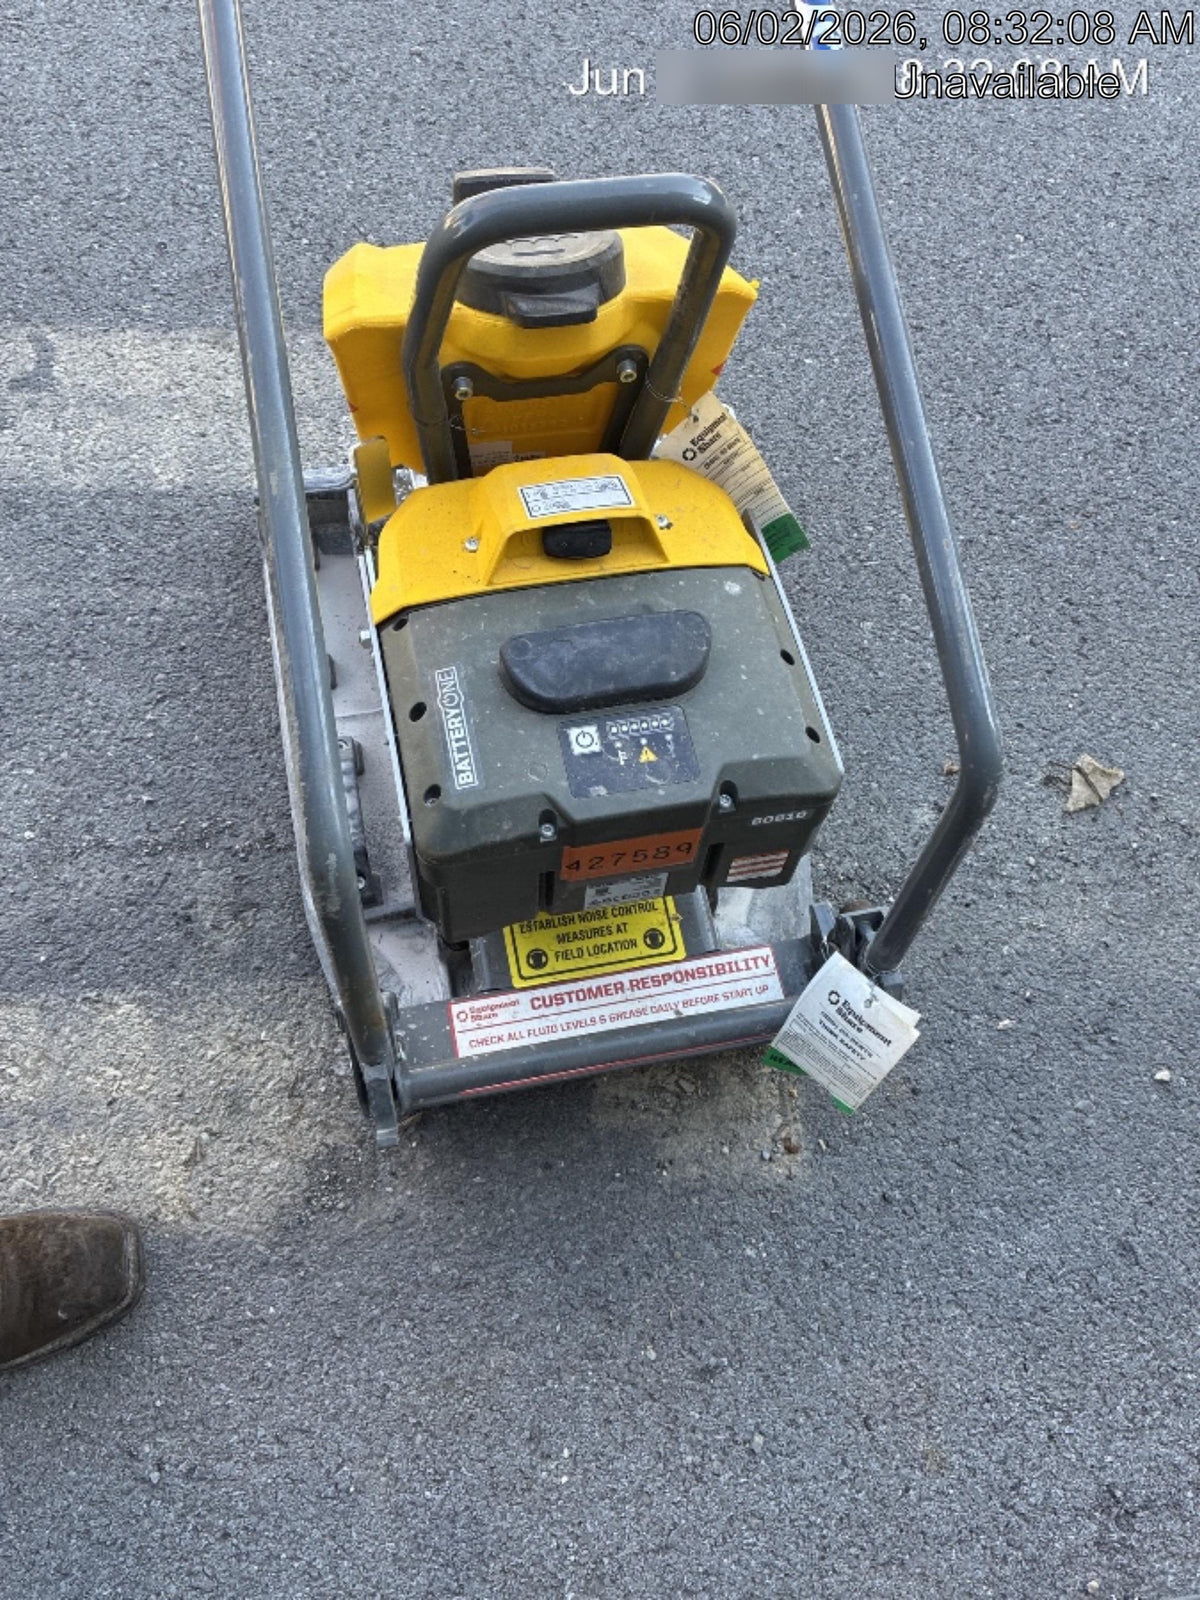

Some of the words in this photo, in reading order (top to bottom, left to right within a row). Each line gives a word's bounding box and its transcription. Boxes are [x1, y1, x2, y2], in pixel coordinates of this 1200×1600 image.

[564, 841, 693, 873] 427589
[519, 913, 577, 935] ESTABLISH
[577, 908, 610, 927] NOISE
[610, 902, 659, 920] CONTROL
[556, 925, 614, 945] MEASURES
[615, 923, 628, 936] AT
[555, 947, 586, 963] FIELD
[587, 939, 638, 959] LOCATION
[530, 982, 625, 1011] CUSTOMER
[630, 954, 771, 993] RESPONSIBILITY
[469, 1035, 504, 1049] CHECK
[507, 1030, 525, 1042] ALL
[527, 1024, 558, 1038] FLUID
[560, 1016, 597, 1033] LEVELS
[608, 1007, 650, 1023] GREASE
[650, 1001, 681, 1016] DAILY
[682, 993, 720, 1009] BEFORE
[722, 986, 754, 1001] START
[755, 983, 769, 997] UP
